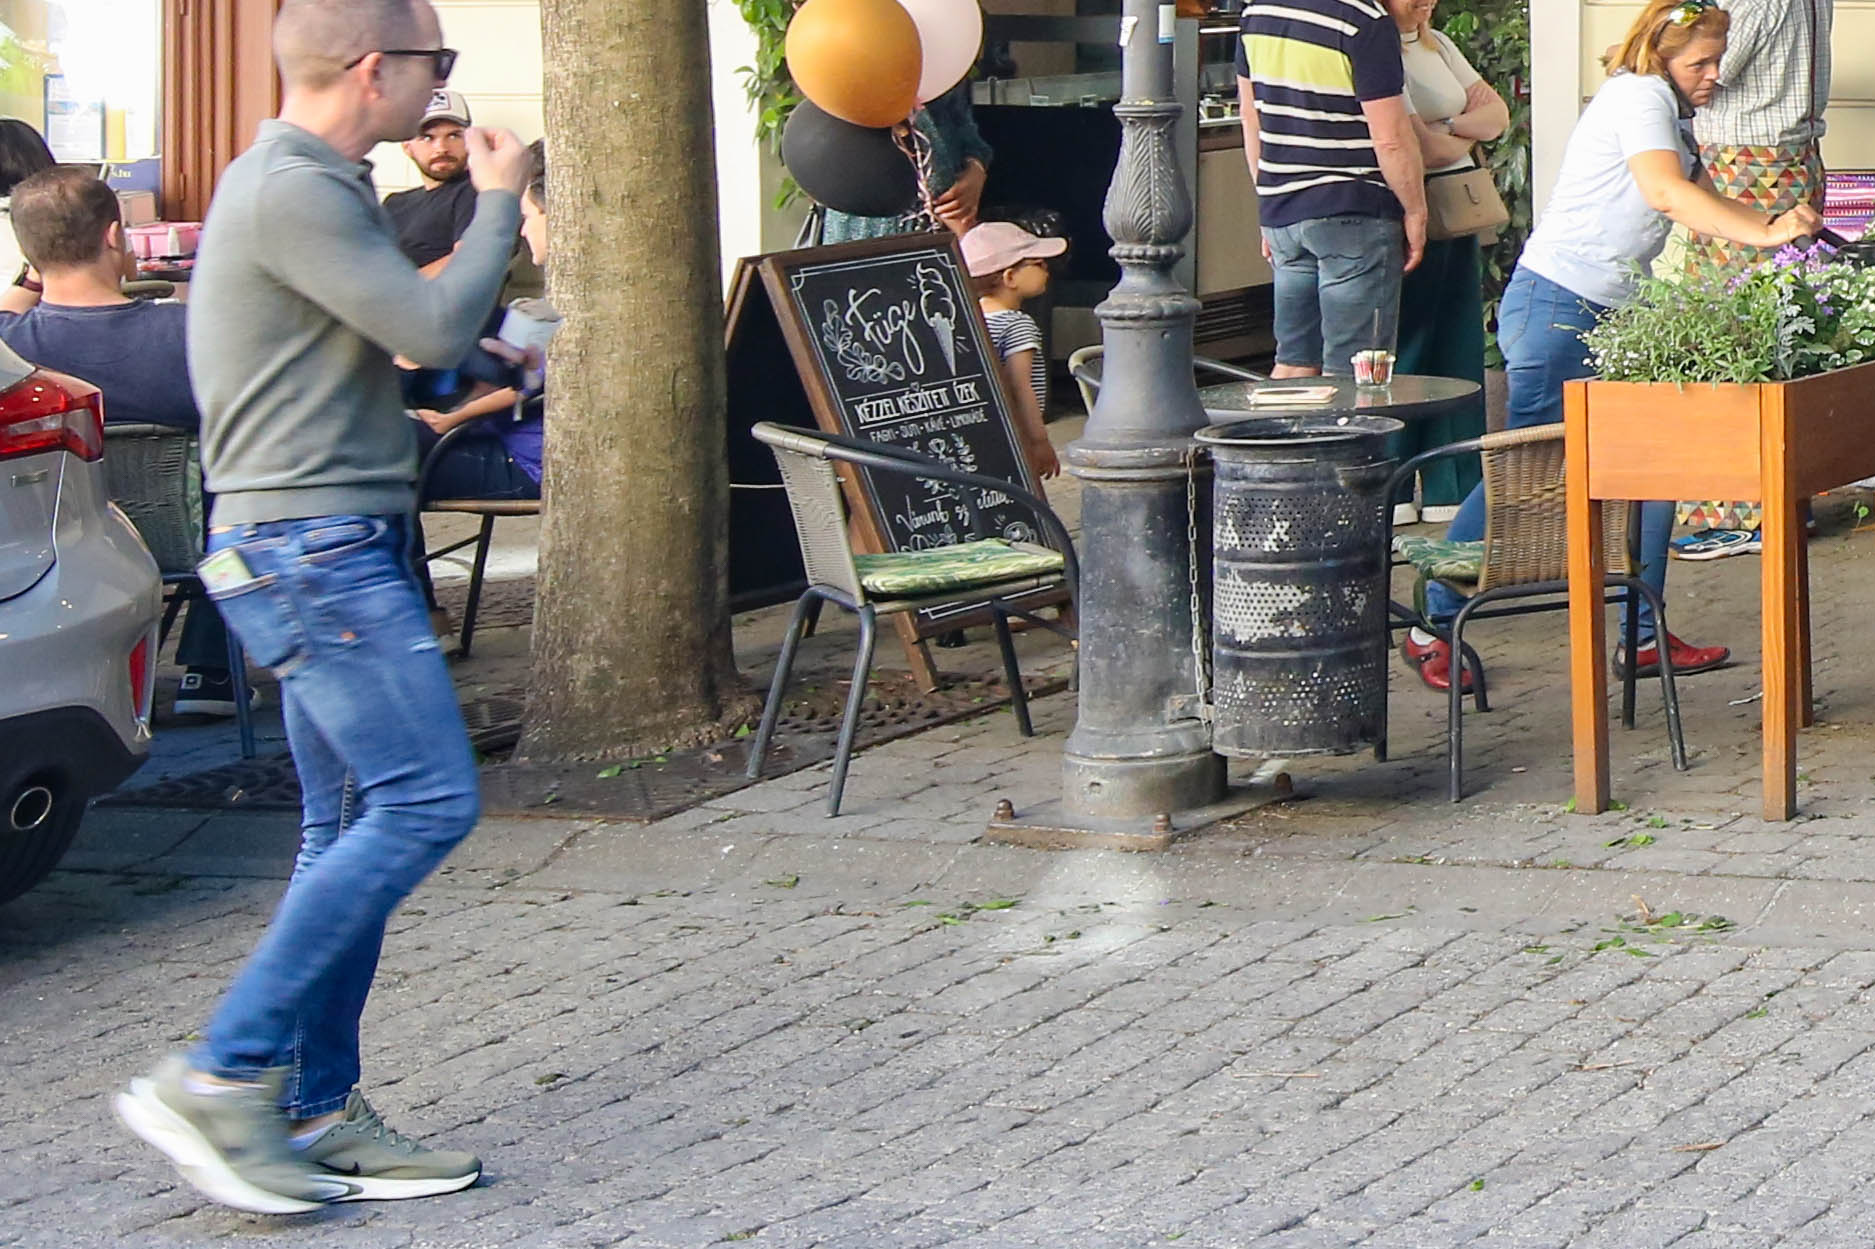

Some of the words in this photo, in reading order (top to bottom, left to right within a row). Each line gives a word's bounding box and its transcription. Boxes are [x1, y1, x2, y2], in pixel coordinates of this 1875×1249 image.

[845, 287, 925, 376] Füge
[854, 397, 901, 424] KÉZZEL
[952, 381, 981, 404] ÍZEK
